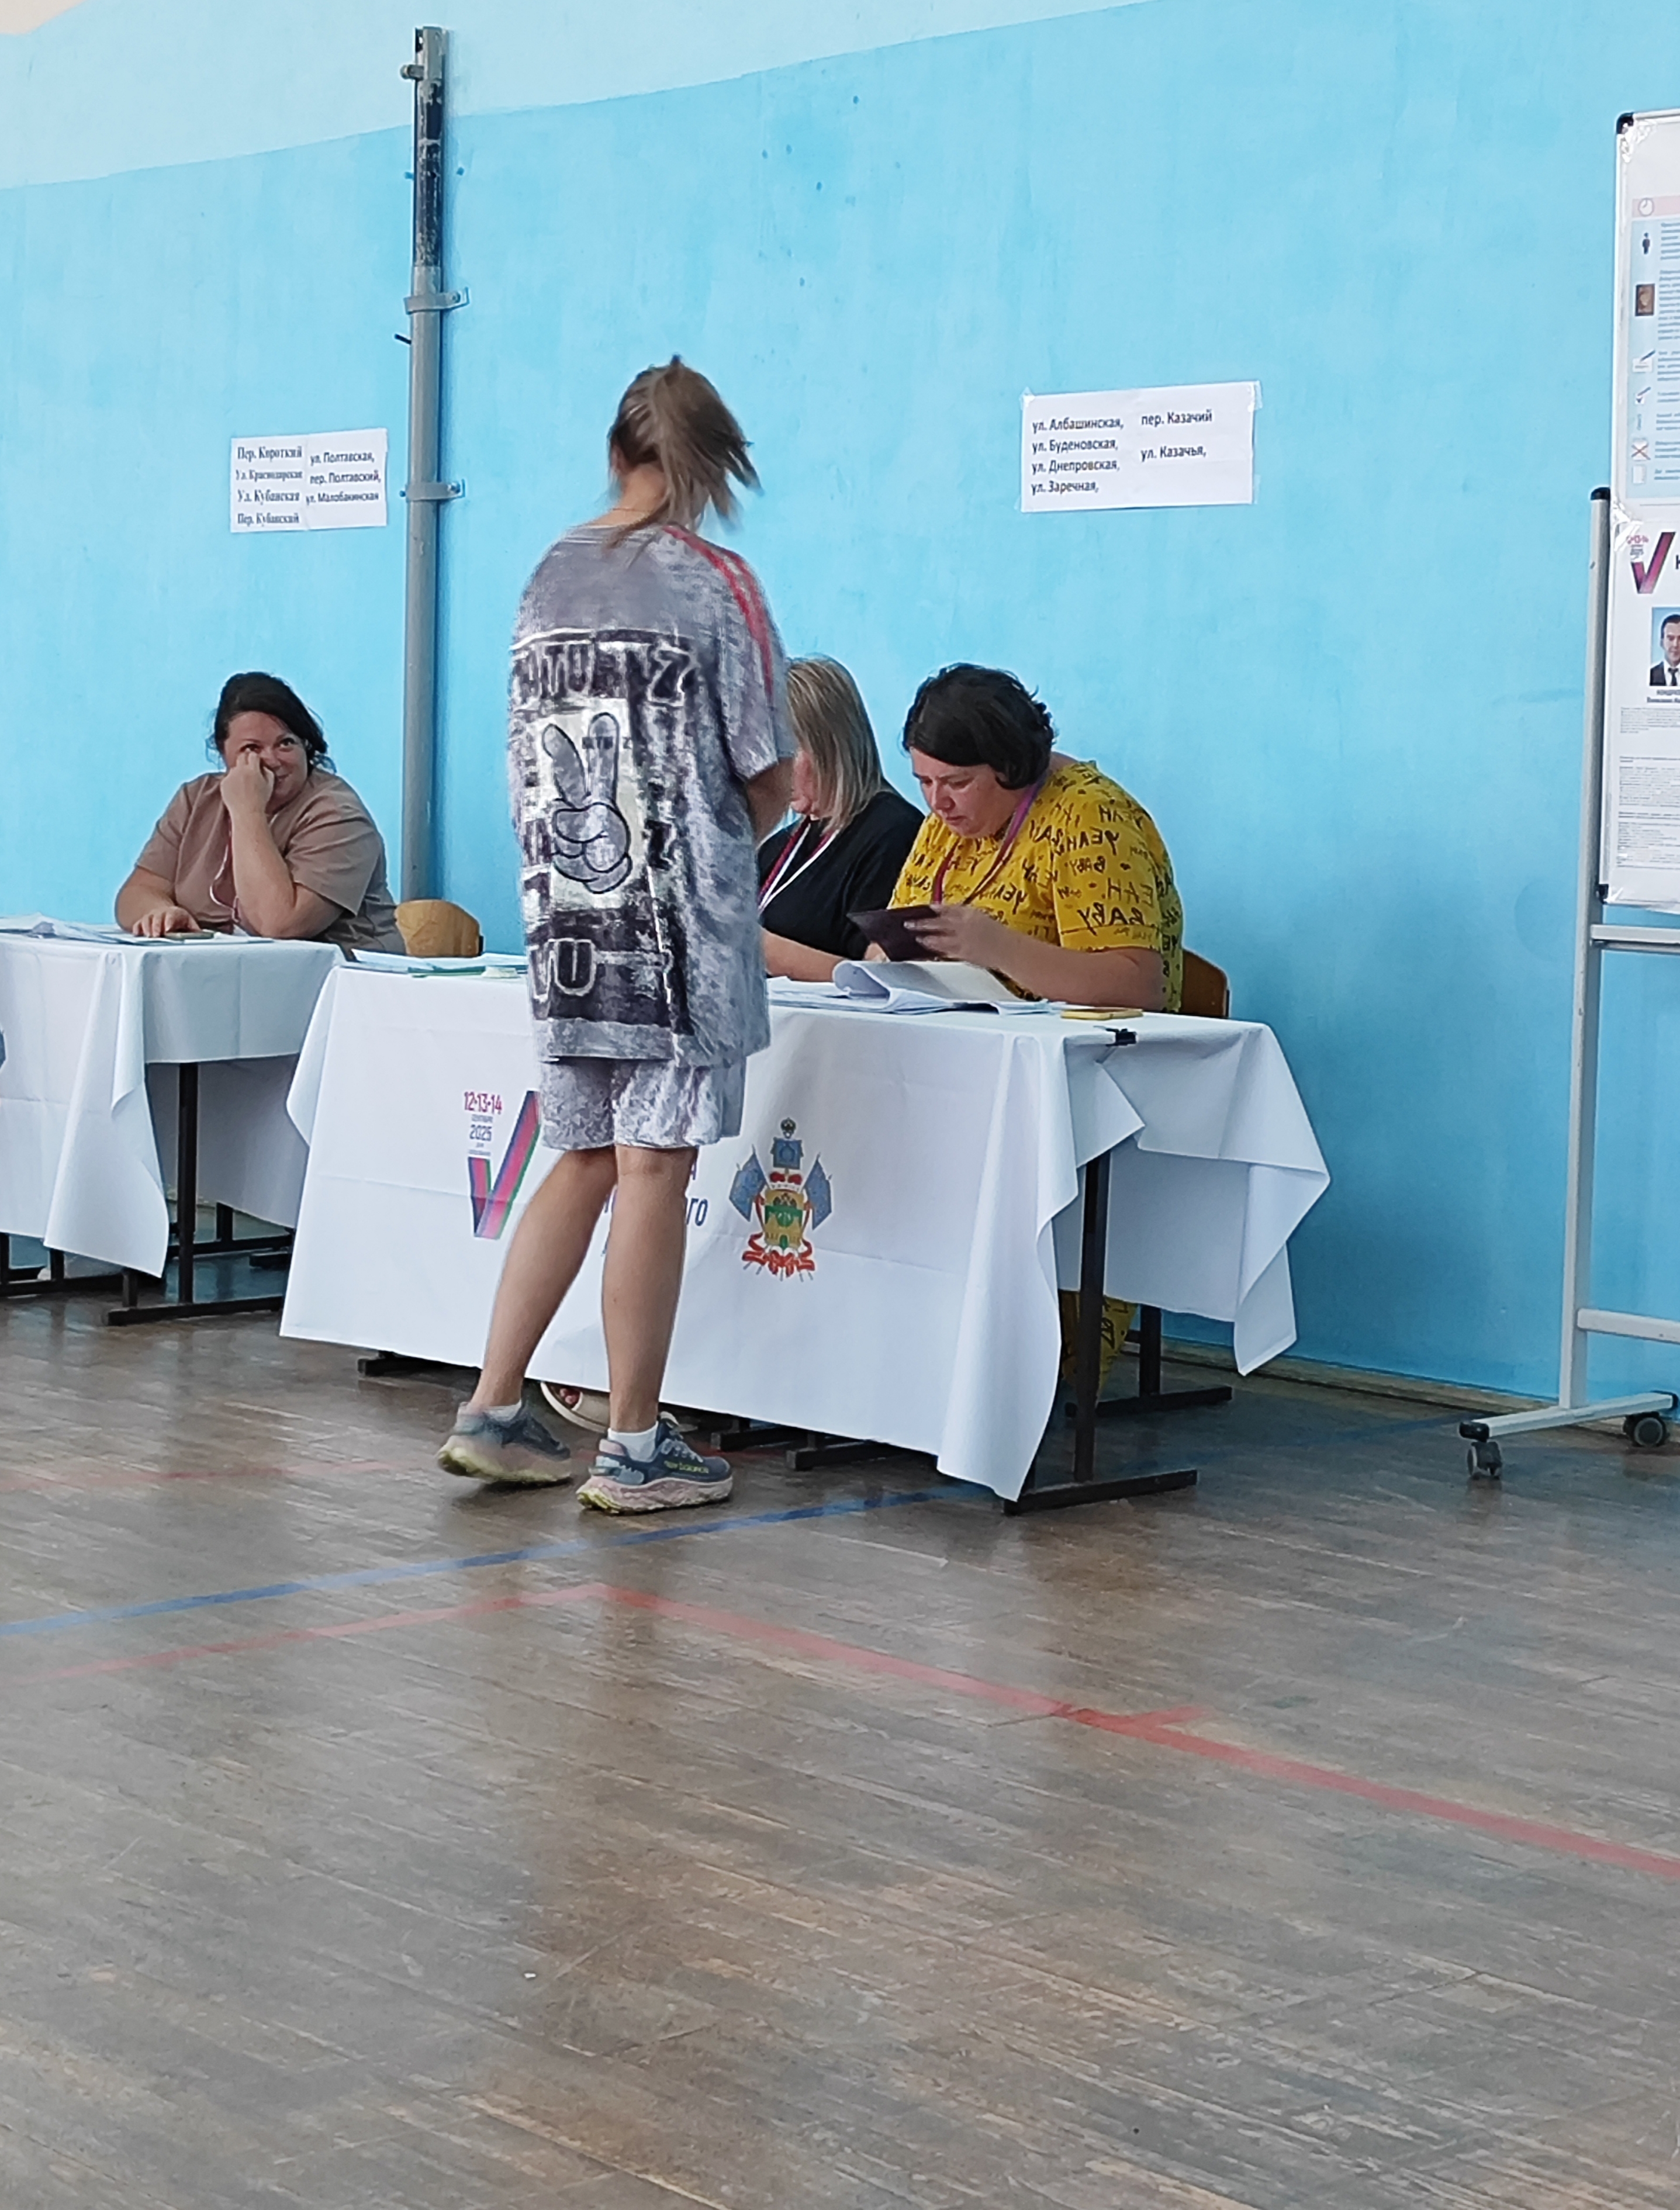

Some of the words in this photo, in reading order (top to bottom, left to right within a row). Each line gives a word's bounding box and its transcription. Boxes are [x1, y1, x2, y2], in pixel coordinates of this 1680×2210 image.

[1032, 421, 1047, 434] ул.
[1049, 417, 1124, 431] Албашинская,
[1141, 414, 1165, 428] пер.
[1167, 409, 1213, 424] Казачий
[237, 447, 256, 462] Пер.
[259, 446, 302, 462] Короткий
[1032, 441, 1047, 454] ул.
[1049, 438, 1118, 454] Буденовская,
[1140, 448, 1157, 462] ул.
[1160, 445, 1207, 458] Казачья,
[323, 452, 375, 464] Полтавская,
[1032, 462, 1046, 475] ул.
[1049, 459, 1120, 474] Днепровская,
[310, 475, 326, 485] пер.
[329, 469, 381, 483] Полтавский,
[1031, 483, 1046, 496] ул.
[1048, 480, 1099, 494] Заречная,
[254, 489, 300, 505] Кубанская
[237, 513, 254, 527] Пер.
[256, 512, 299, 527] Кубанский
[469, 1124, 492, 1142] 2025
